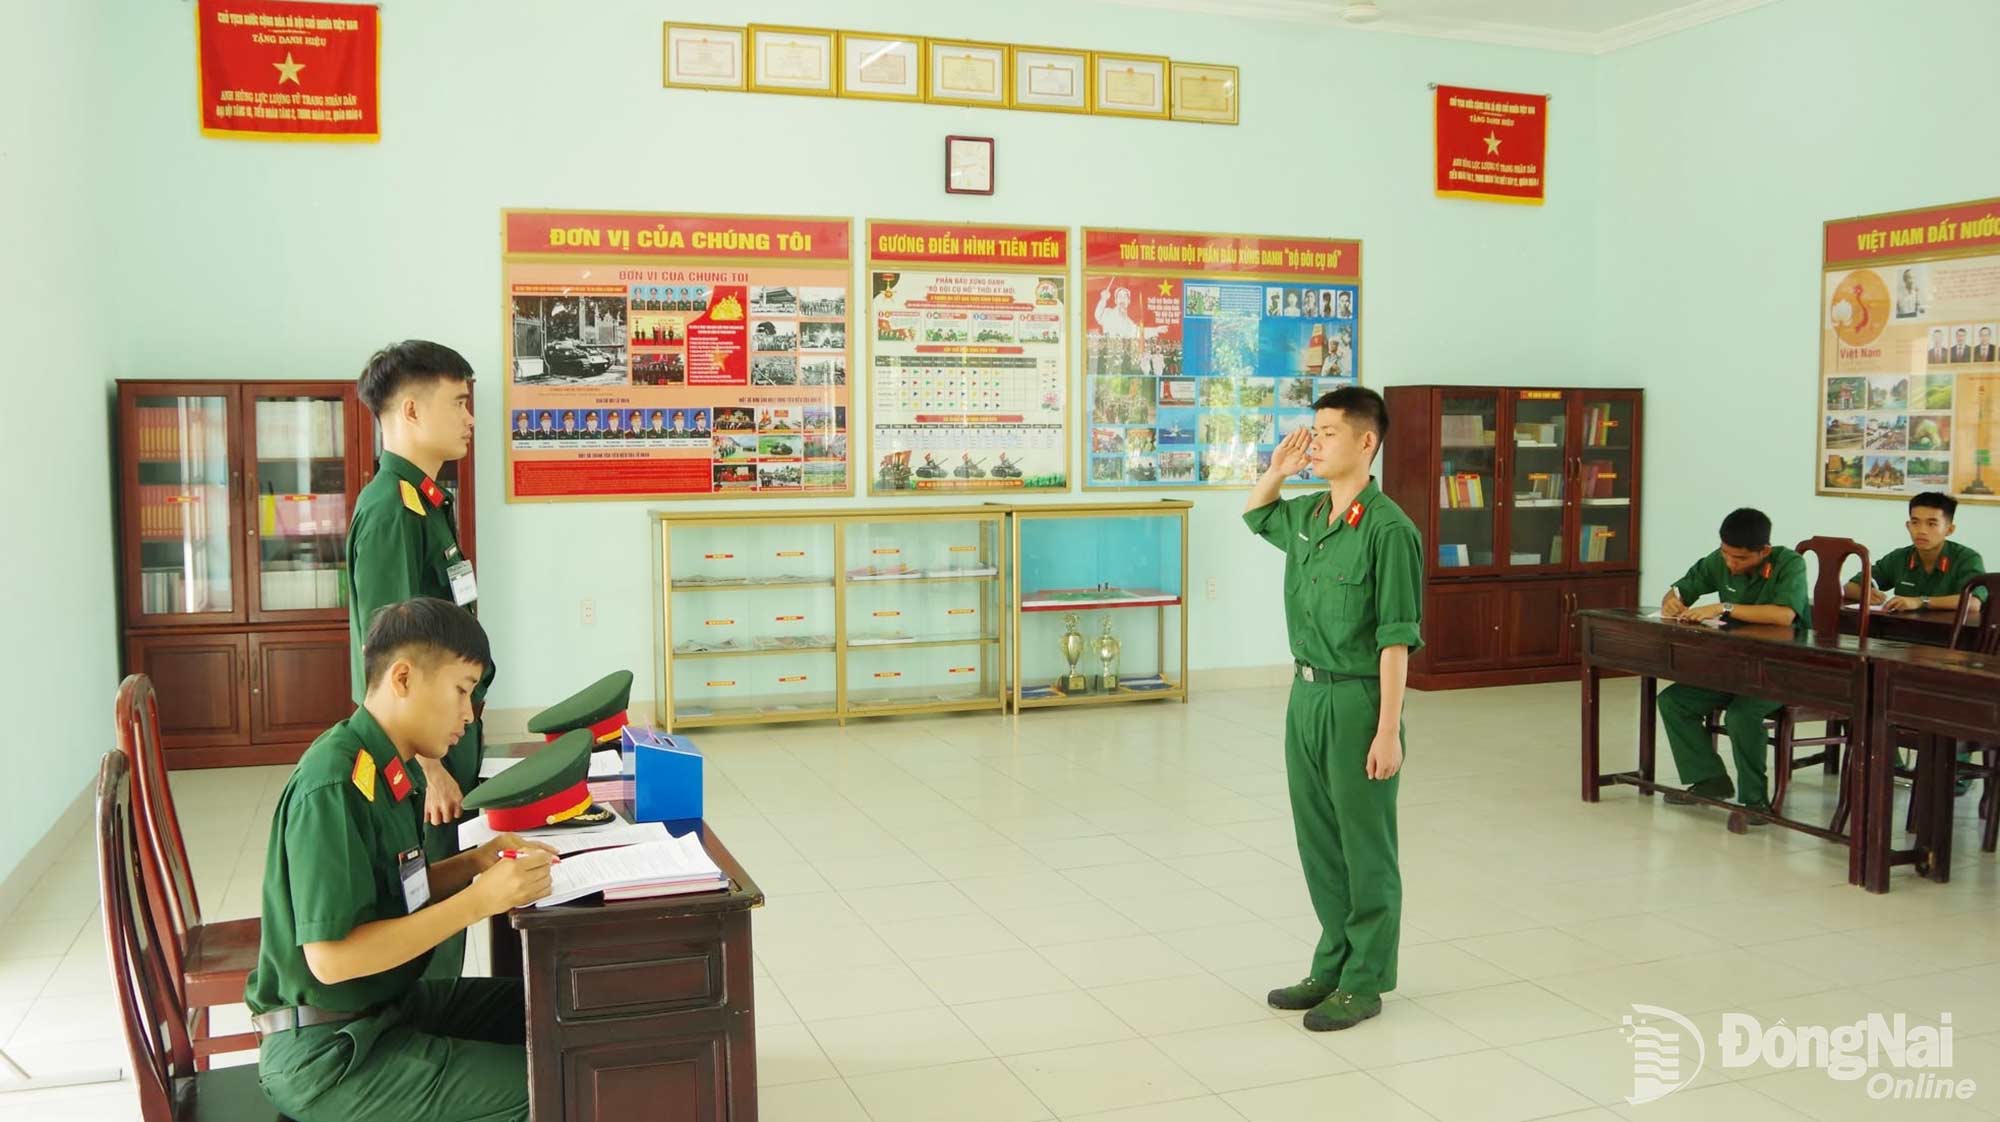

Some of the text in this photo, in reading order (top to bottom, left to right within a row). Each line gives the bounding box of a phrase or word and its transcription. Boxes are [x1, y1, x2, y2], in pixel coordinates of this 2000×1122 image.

[252, 33, 326, 47] TẶNG DANH HIỆU
[550, 224, 812, 251] ĐƠN VỊ CỦA CHÚNG TÔI
[879, 232, 1059, 258] GƯƠNG ĐIỂN HÌNH TIÊN TIẾN
[1857, 229, 1887, 252] VIỆT
[1890, 227, 1924, 247] NAM
[1927, 218, 1957, 243] ĐẤT
[1120, 239, 1139, 259] TUỔI
[1140, 240, 1155, 260] TRẺ
[1158, 243, 1180, 262] QUÂN
[1182, 244, 1195, 265] ĐỘI
[1197, 243, 1219, 263] PHẤN
[1221, 243, 1237, 263] ĐẤU
[1239, 246, 1259, 264] XỨNG
[1262, 250, 1282, 265] DANH
[1301, 249, 1314, 267] ĐỘI
[1315, 252, 1326, 270] CỤ
[1840, 348, 1882, 360] Việt Nam
